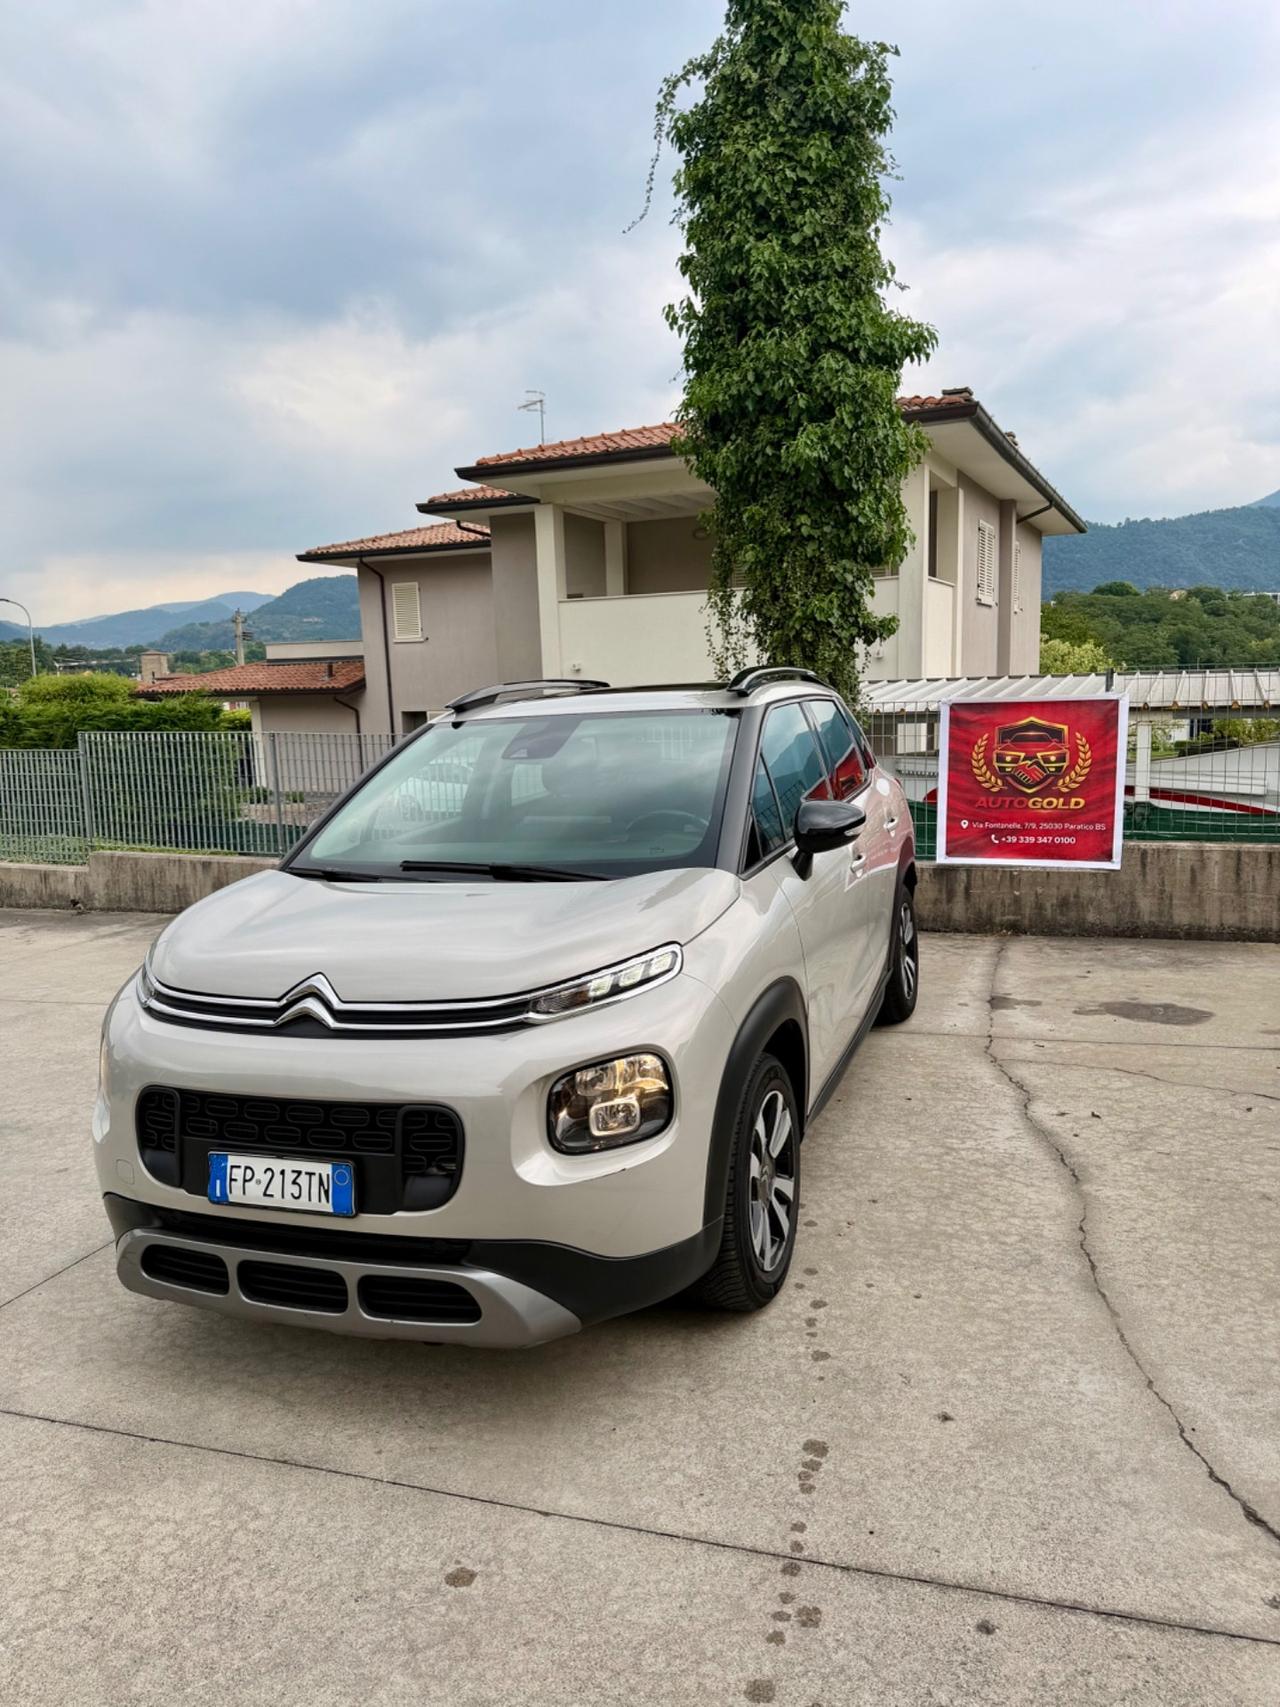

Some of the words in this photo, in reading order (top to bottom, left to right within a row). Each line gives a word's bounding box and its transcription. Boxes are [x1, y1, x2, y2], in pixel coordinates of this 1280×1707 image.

[976, 797, 1085, 809] AUTOGOLD
[1064, 823, 1094, 831] Paratico
[1018, 836, 1035, 844] 339
[1036, 836, 1052, 844] 347
[1054, 836, 1076, 844] 0100
